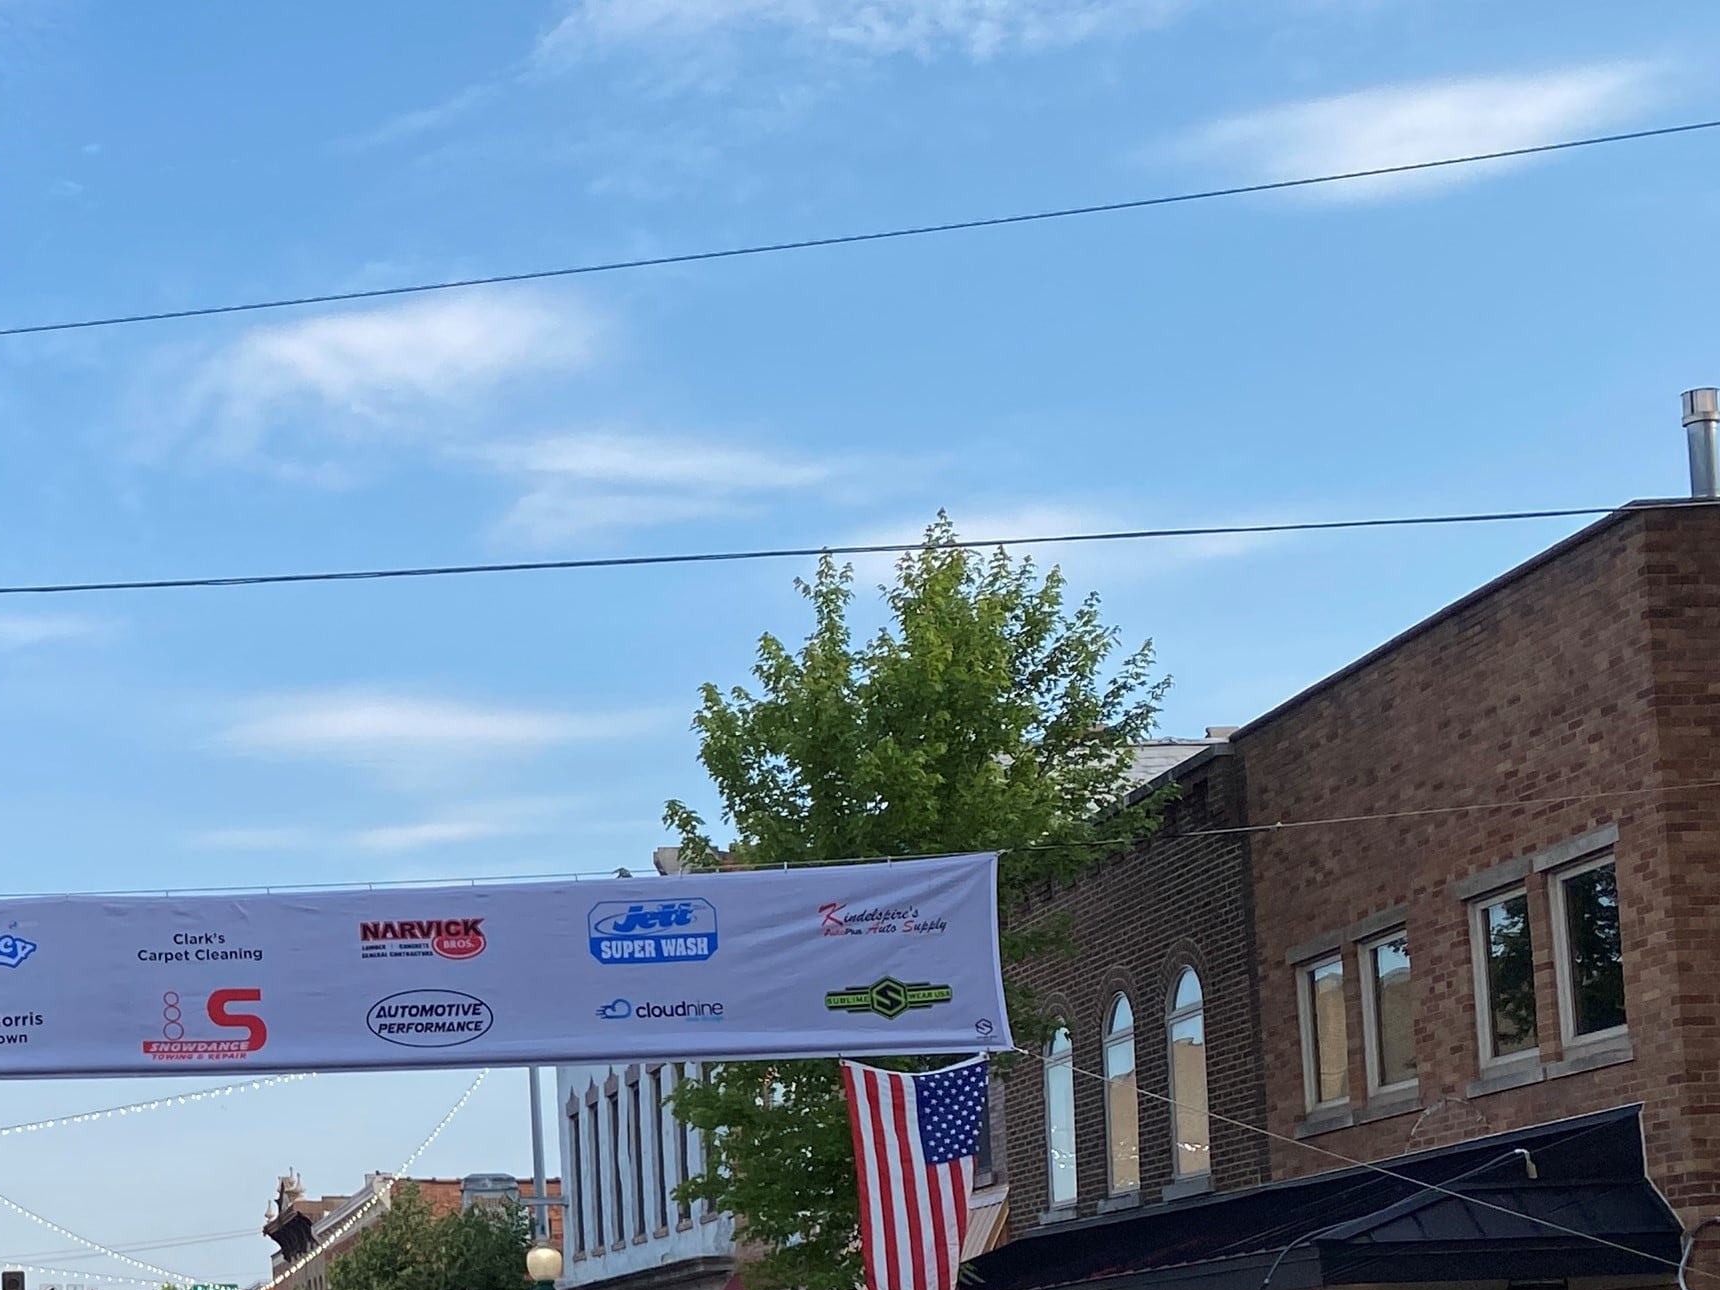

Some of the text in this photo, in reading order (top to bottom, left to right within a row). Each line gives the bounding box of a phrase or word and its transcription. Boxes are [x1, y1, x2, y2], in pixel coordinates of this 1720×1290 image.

[360, 918, 485, 941] NARVICK
[866, 923, 897, 934] Auto
[902, 918, 948, 933] Supply
[173, 933, 226, 945] Clark's
[443, 939, 475, 949] BROS.
[600, 937, 709, 959] SUPER WASH
[137, 948, 263, 963] Carpet Cleaning
[827, 996, 869, 1005] SUBLIME
[909, 990, 950, 1000] WEAR USA
[376, 1003, 483, 1018] AUTOMOTIVE
[636, 1001, 724, 1018] cloudnine
[378, 1021, 484, 1034] PERFORMANCE
[150, 1041, 249, 1052] SNOWDANCE
[208, 1052, 247, 1060] REPAIR
